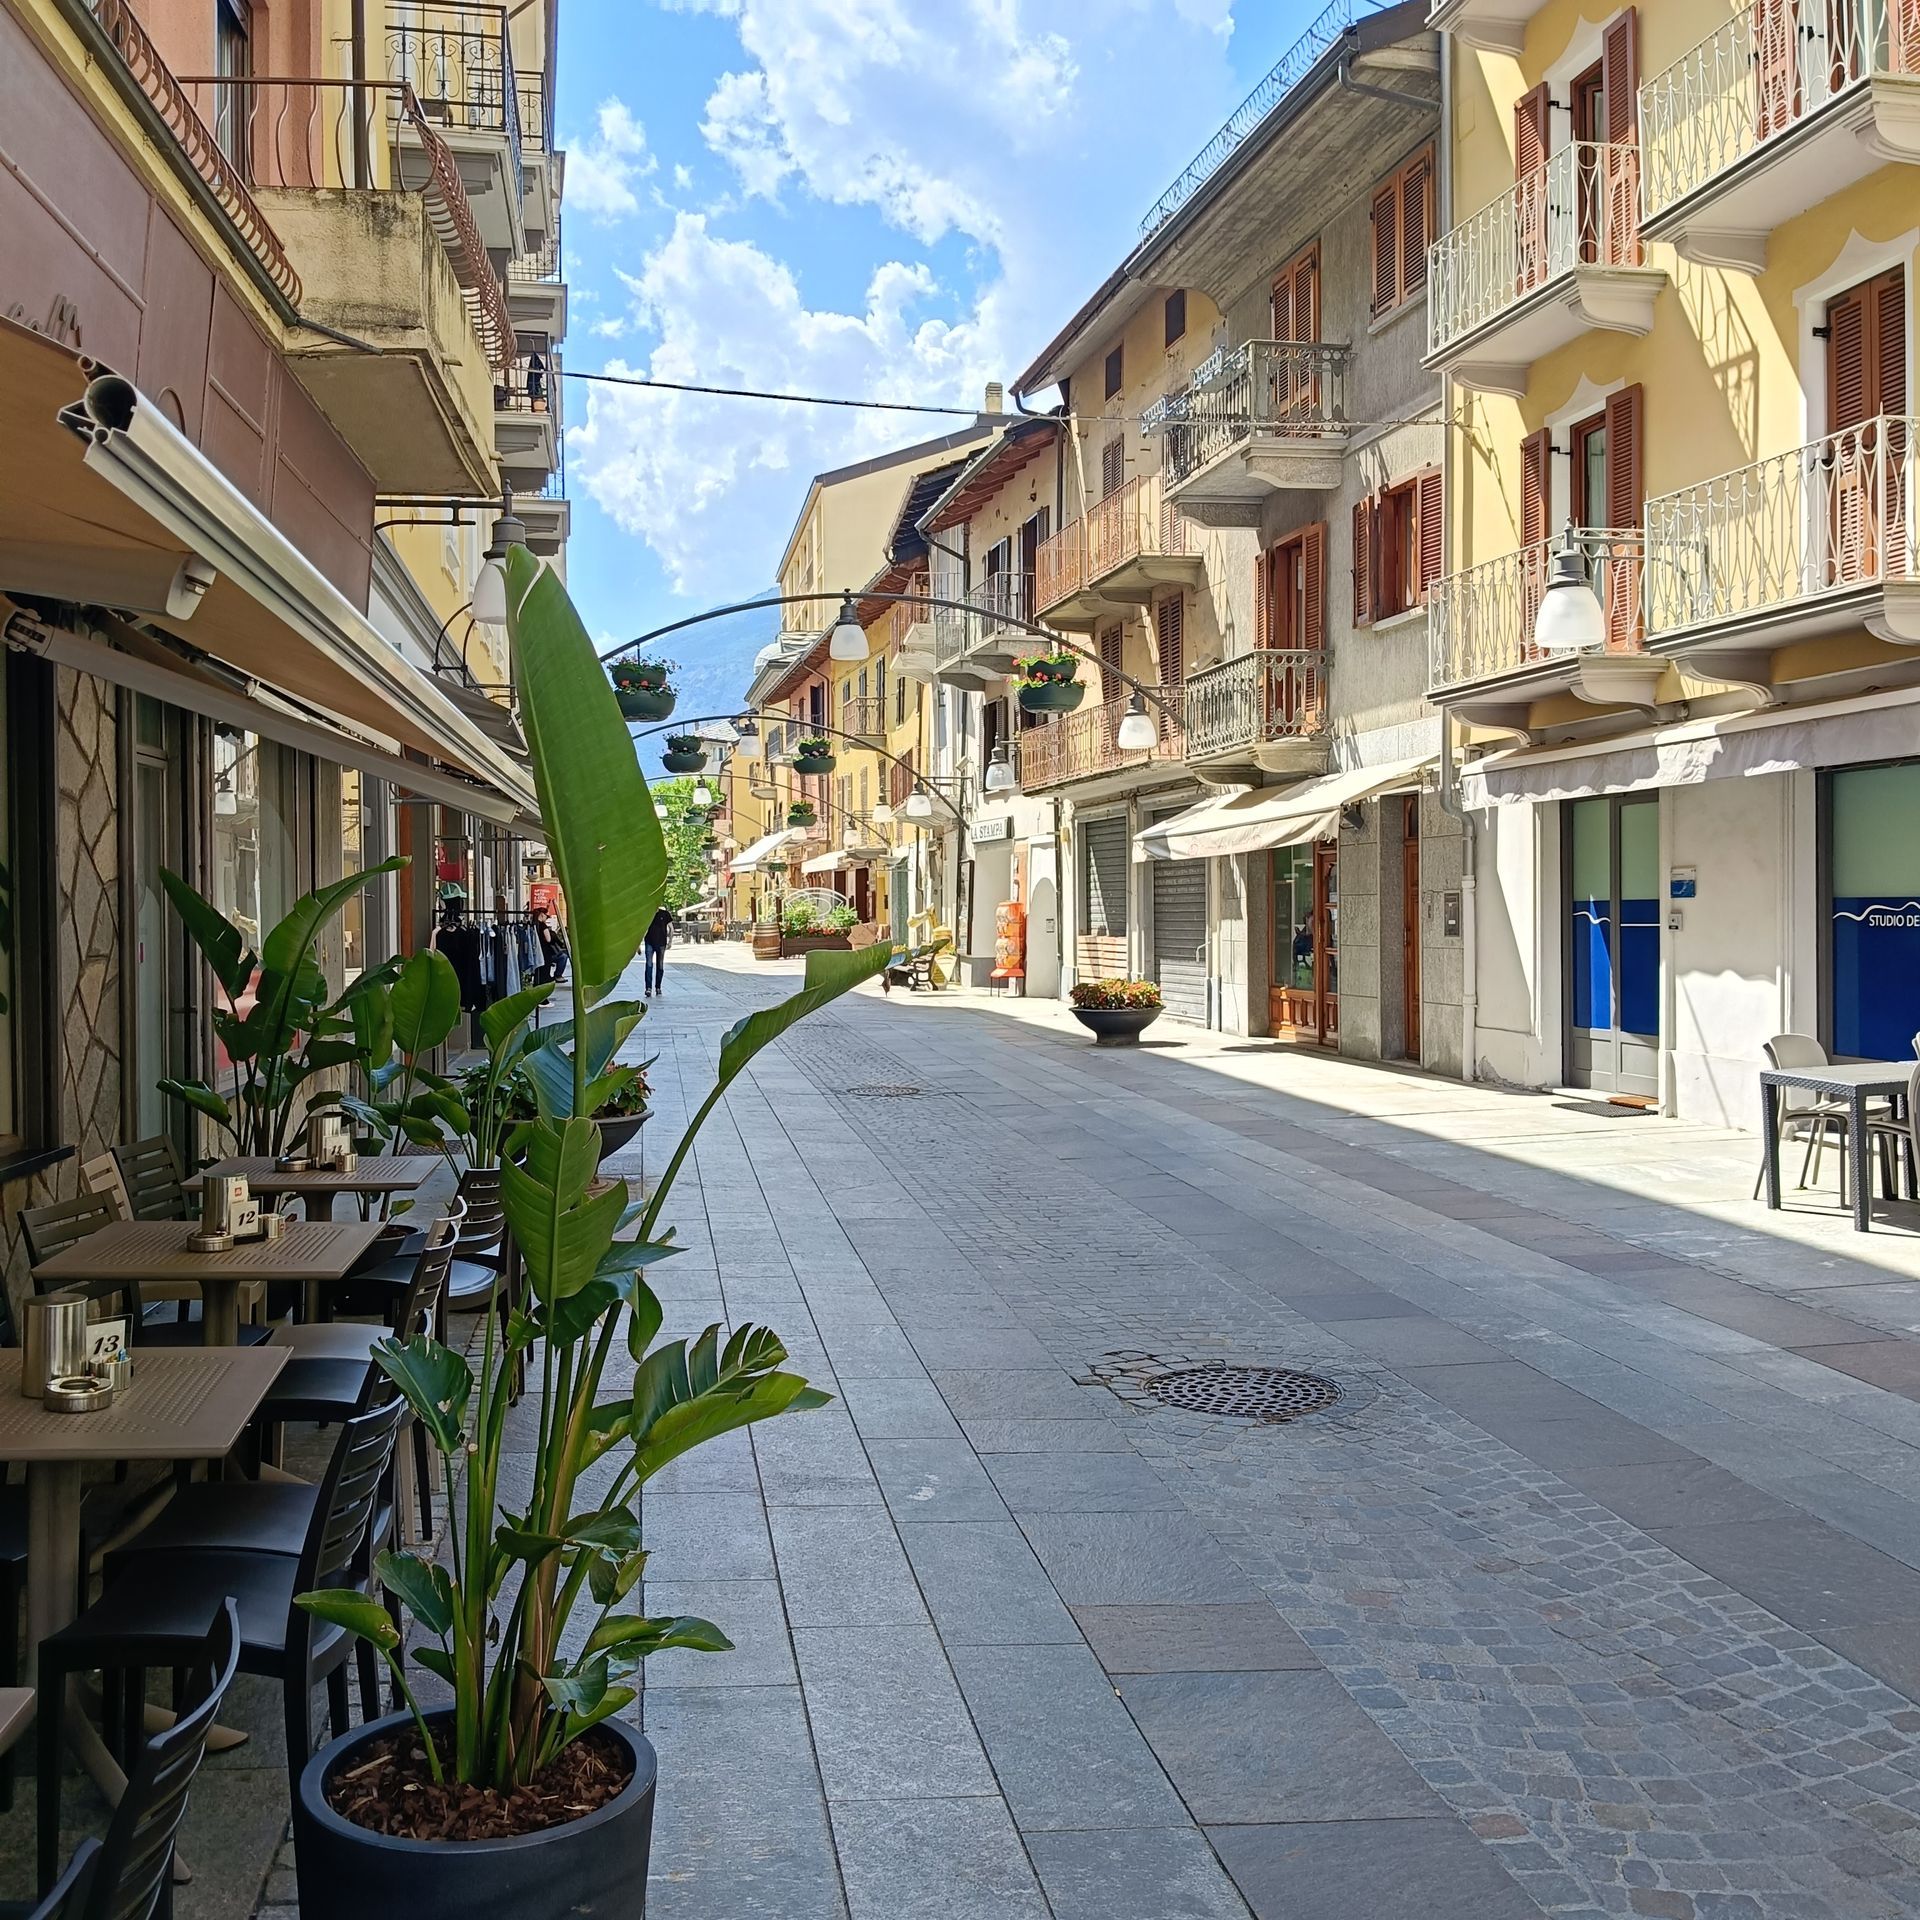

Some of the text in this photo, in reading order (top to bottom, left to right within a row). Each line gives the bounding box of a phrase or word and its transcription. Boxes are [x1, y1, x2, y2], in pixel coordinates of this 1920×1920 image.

[970, 822, 1004, 840] LA STAMPA
[1868, 914, 1920, 927] STUDIO DE
[238, 1210, 256, 1227] 12
[93, 1335, 120, 1355] 13
